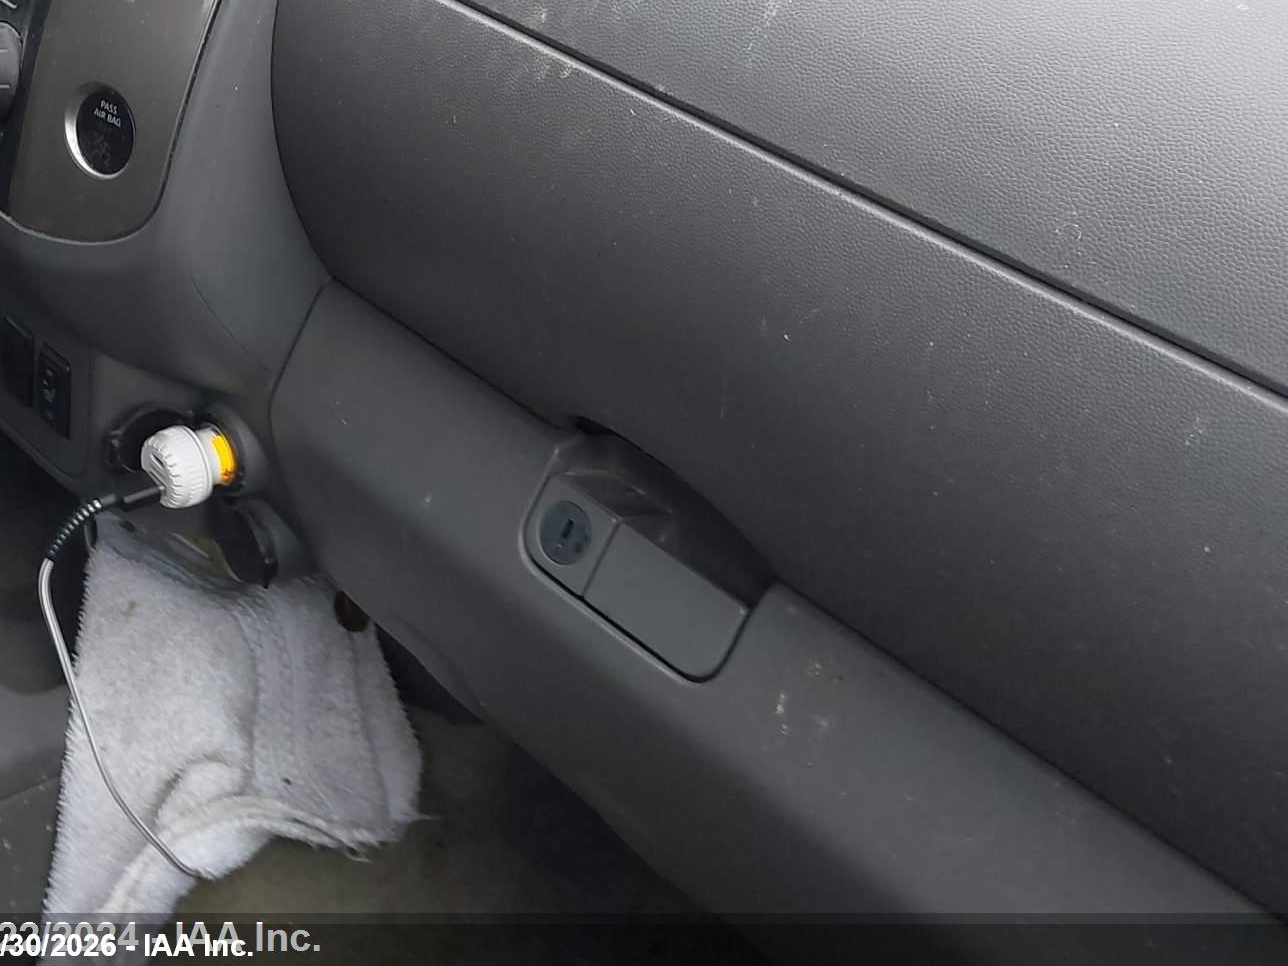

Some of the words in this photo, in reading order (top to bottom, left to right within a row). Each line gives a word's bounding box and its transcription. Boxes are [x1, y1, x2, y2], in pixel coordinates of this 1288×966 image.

[101, 100, 117, 114] PASS
[94, 107, 106, 119] AIR
[107, 114, 120, 127] BAG
